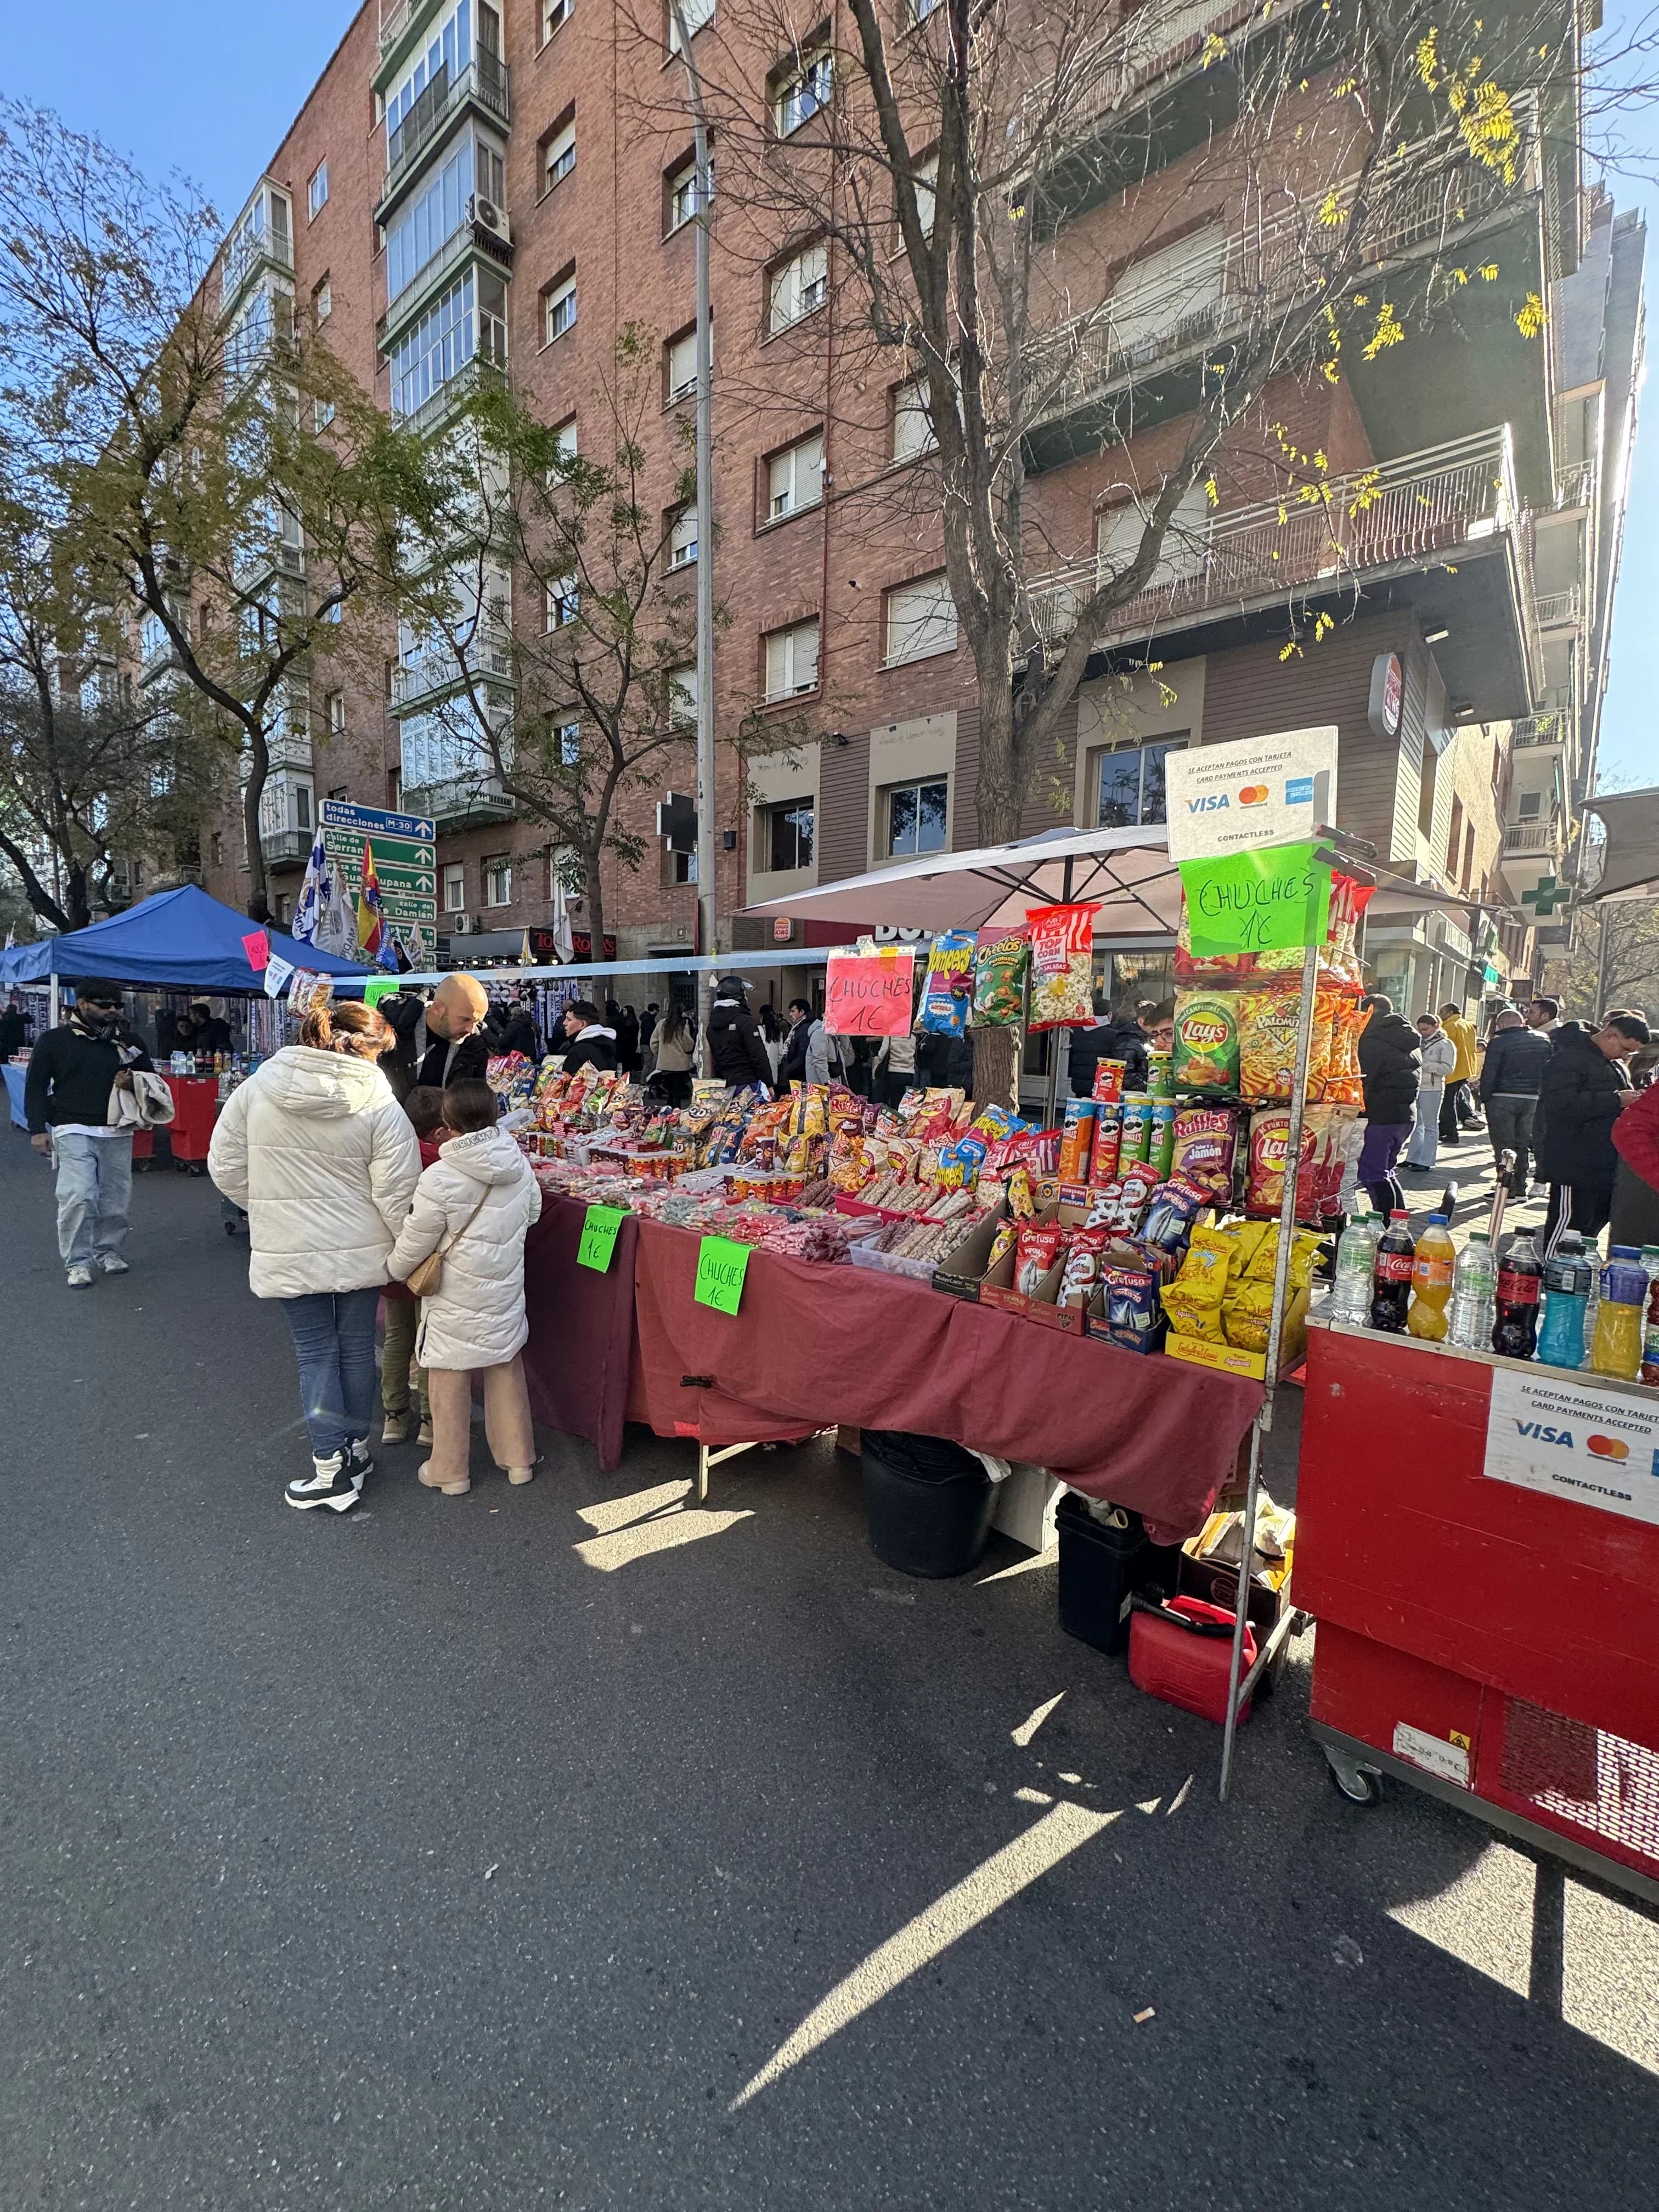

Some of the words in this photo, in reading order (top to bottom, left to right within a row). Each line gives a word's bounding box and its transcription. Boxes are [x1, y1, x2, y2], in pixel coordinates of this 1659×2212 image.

[1197, 763, 1224, 772] ACEPTAN
[1226, 759, 1248, 767] PAGOS
[1264, 752, 1291, 760] TARJETA
[1215, 770, 1249, 780] PAYMENTS
[1250, 764, 1283, 774] ACCEPTED
[326, 804, 356, 815] todas
[1184, 794, 1230, 813] VISA
[326, 813, 385, 830] direcciones
[388, 819, 410, 830] M-30
[1217, 830, 1274, 842] CONTACTLESS
[326, 841, 363, 854] Serran
[1200, 872, 1316, 916] CHUCHES
[395, 907, 433, 919] Damián
[399, 900, 417, 909] calle
[978, 937, 1022, 964] Cheetos
[1037, 947, 1061, 958] CORN
[1040, 938, 1062, 950] TOP
[830, 976, 911, 1002] CHUCHES
[850, 1006, 883, 1032] 1€
[1256, 1015, 1300, 1029] PALOMIT
[1184, 1021, 1226, 1044] Lay's
[1172, 1110, 1228, 1138] Ruffles
[1267, 1121, 1289, 1130] PUNTO
[452, 1130, 493, 1151] BRIGHT
[1189, 1144, 1222, 1160] Jamón
[1062, 1188, 1085, 1196] Mostaza
[1167, 1178, 1203, 1201] Grefusa
[1061, 1198, 1084, 1206] Ketchup
[585, 1219, 618, 1235] CHUCHES
[1022, 1232, 1055, 1244] Grefusa
[588, 1239, 601, 1260] 1€
[700, 1253, 744, 1286] CHUCHES
[1108, 1273, 1145, 1285] Grefusa
[708, 1286, 725, 1306] 1€
[1532, 1388, 1572, 1402] ACEPTAN
[1573, 1397, 1603, 1409] PAGOS
[1605, 1404, 1625, 1415] CON
[1627, 1409, 1659, 1424] TARJET
[1532, 1400, 1555, 1410] CARD
[1556, 1406, 1603, 1423] PAYMENTS
[1605, 1418, 1652, 1434] ACCEPTED
[1512, 1418, 1574, 1448] VISA
[1552, 1474, 1632, 1501] CONTACTLESS
